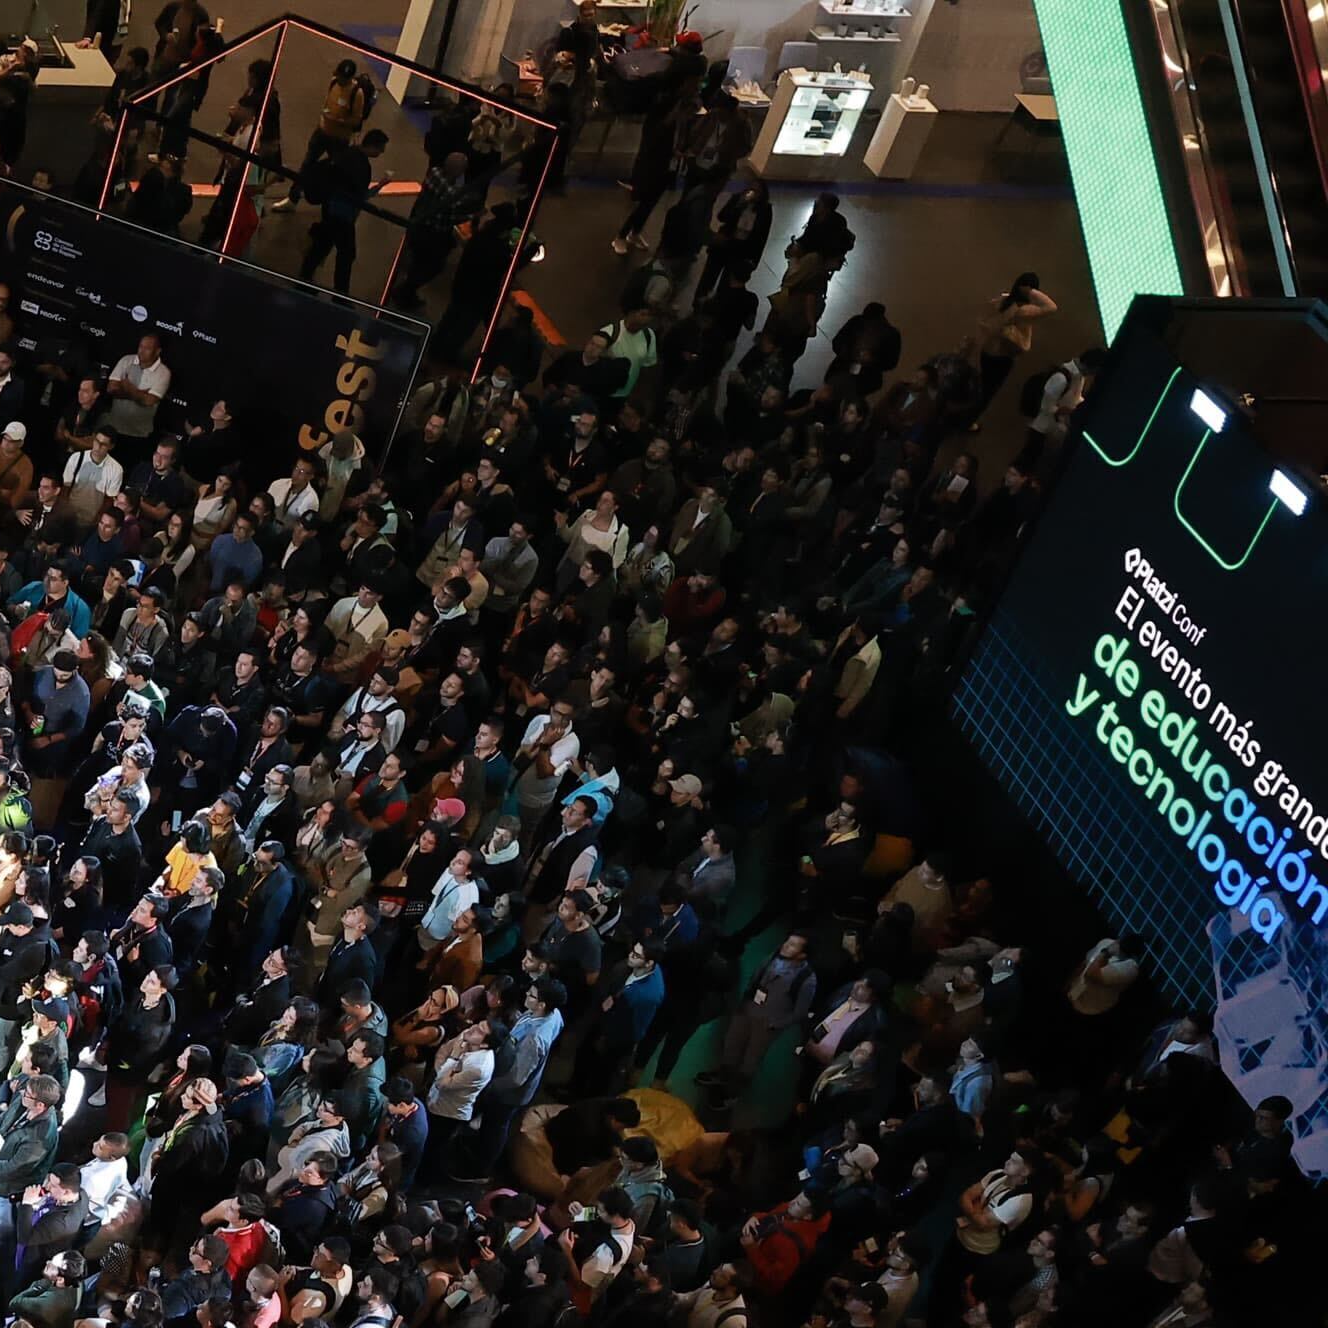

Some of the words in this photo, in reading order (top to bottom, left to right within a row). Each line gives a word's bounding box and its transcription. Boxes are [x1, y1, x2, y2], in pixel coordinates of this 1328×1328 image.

[1115, 585, 1145, 630] El
[1138, 620, 1212, 710] evento
[1209, 701, 1261, 767] más
[1135, 558, 1179, 615] Platzi
[1172, 602, 1208, 647] Conf
[1065, 673, 1100, 717] y
[1096, 701, 1284, 945] tecnología
[1094, 633, 1140, 697] de
[1141, 689, 1328, 925] educación
